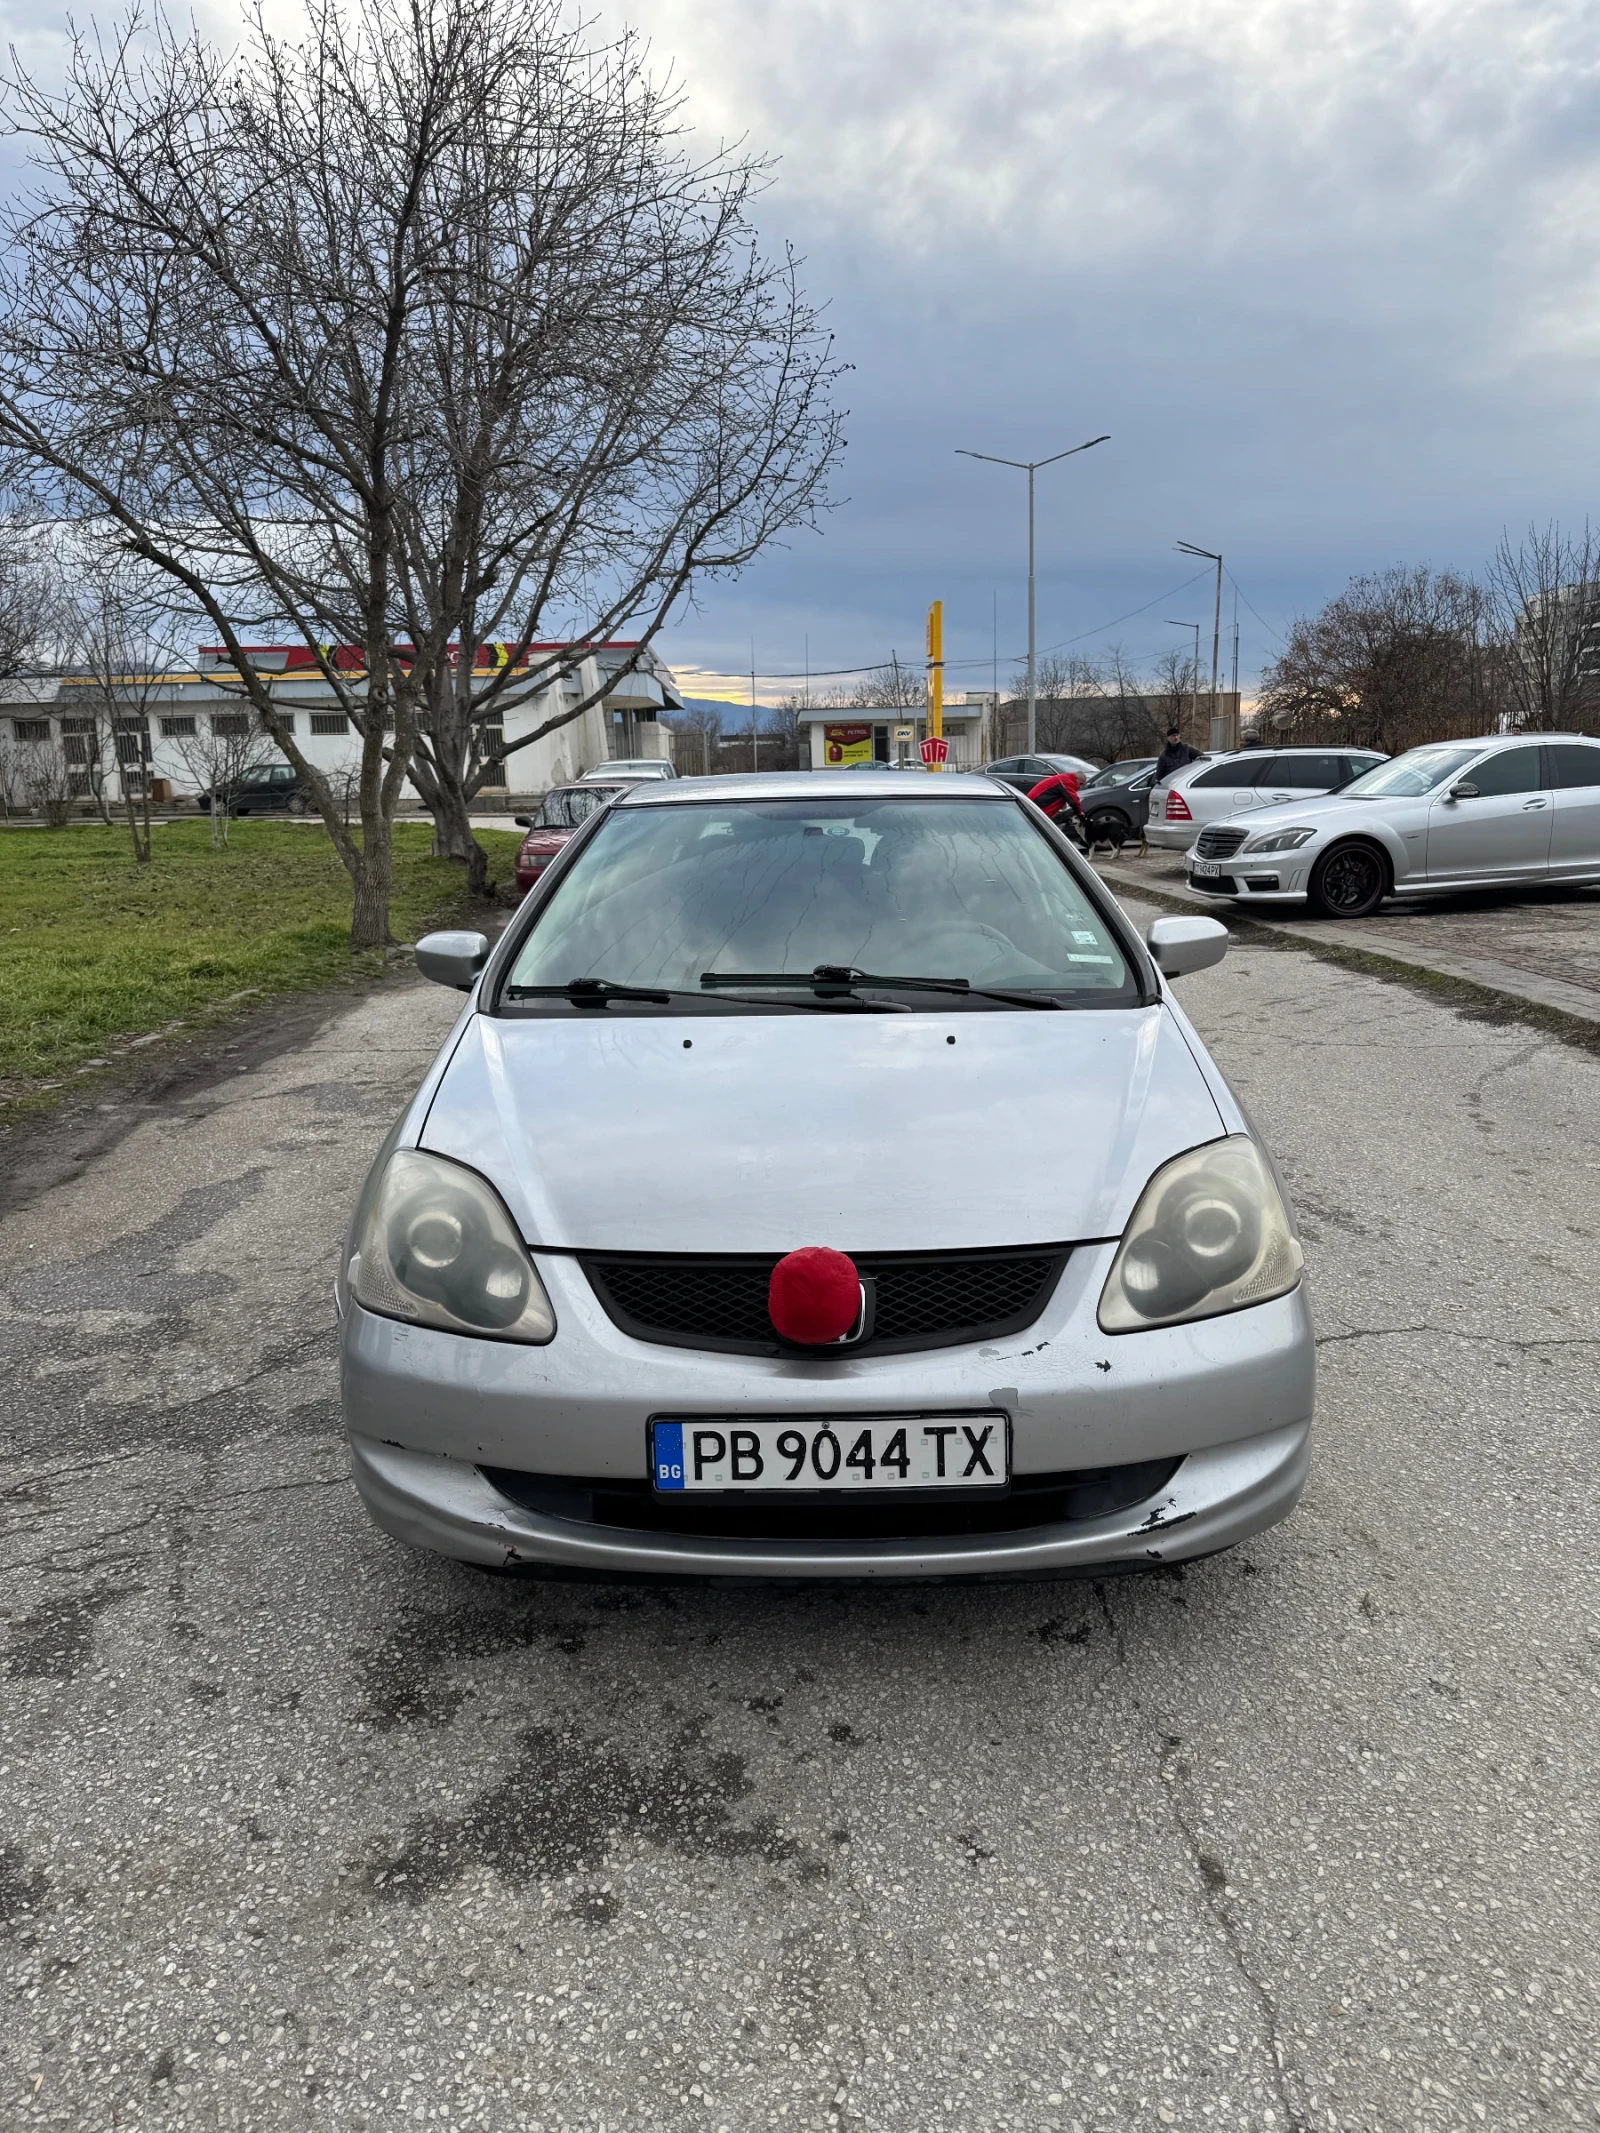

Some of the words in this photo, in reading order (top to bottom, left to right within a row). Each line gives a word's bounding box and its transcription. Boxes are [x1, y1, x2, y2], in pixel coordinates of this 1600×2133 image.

[920, 737, 949, 763] UTA
[693, 1430, 764, 1481] PB
[776, 1429, 910, 1480] 9044
[923, 1425, 995, 1477] TX
[659, 1465, 681, 1479] BG
